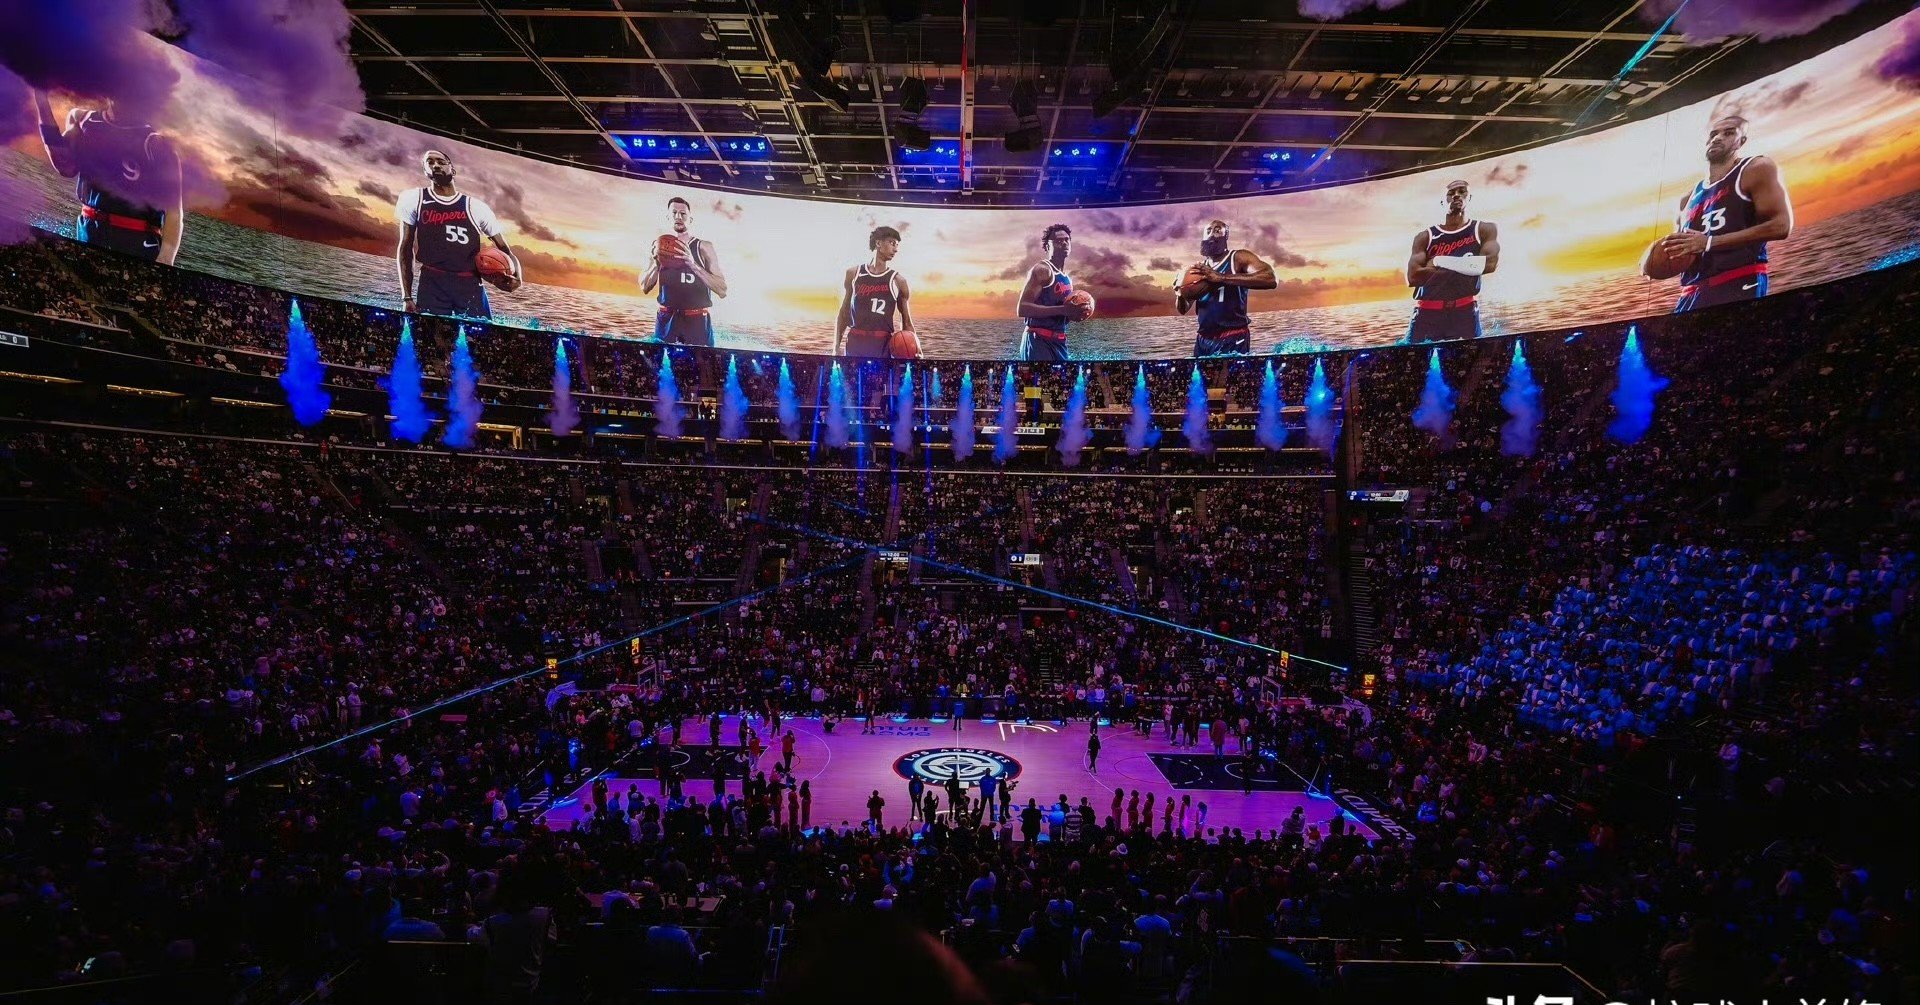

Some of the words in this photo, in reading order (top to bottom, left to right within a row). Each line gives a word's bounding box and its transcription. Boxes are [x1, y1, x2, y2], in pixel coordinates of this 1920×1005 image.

[421, 209, 467, 226] Clippers
[1701, 207, 1727, 235] 33
[445, 224, 470, 245] 55
[1429, 234, 1476, 257] Clippers
[1217, 285, 1225, 303] 1
[870, 297, 886, 315] 12
[904, 750, 930, 762] LOS
[940, 748, 1010, 764] ANGELES
